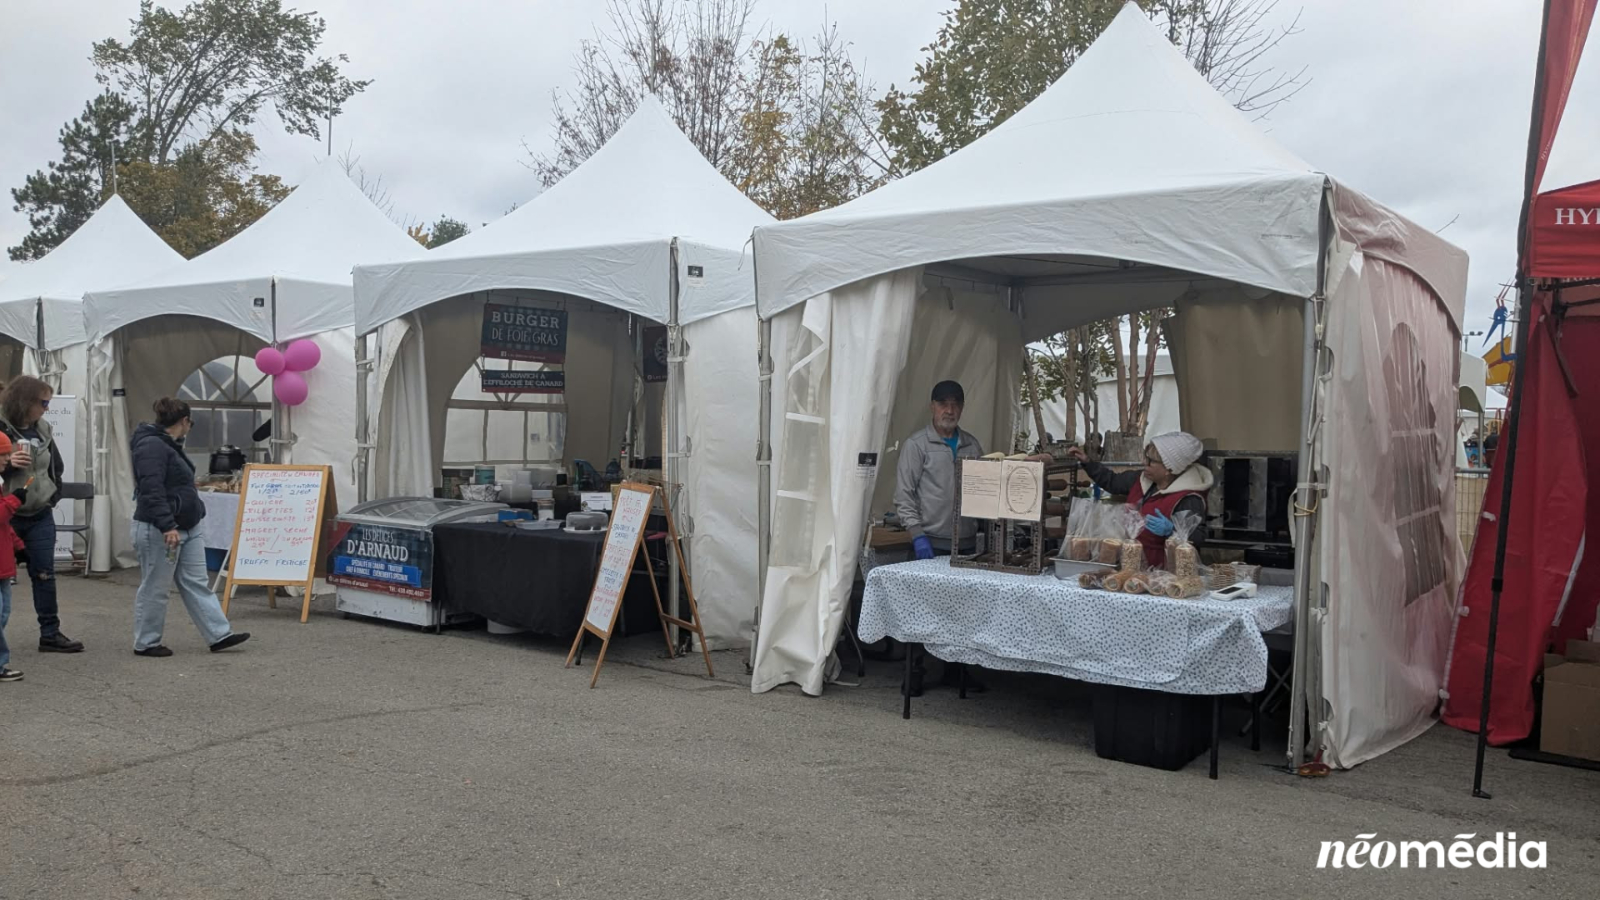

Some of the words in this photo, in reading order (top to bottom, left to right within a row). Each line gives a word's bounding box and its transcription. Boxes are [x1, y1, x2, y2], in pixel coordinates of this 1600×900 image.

[491, 311, 560, 329] BURGER
[491, 327, 503, 341] DE
[507, 328, 530, 343] FOIE
[532, 331, 559, 346] GRAS
[60, 407, 71, 415] du
[362, 528, 371, 541] LES
[346, 539, 409, 562] D'ARNAUD
[238, 557, 270, 566] TRUFFE
